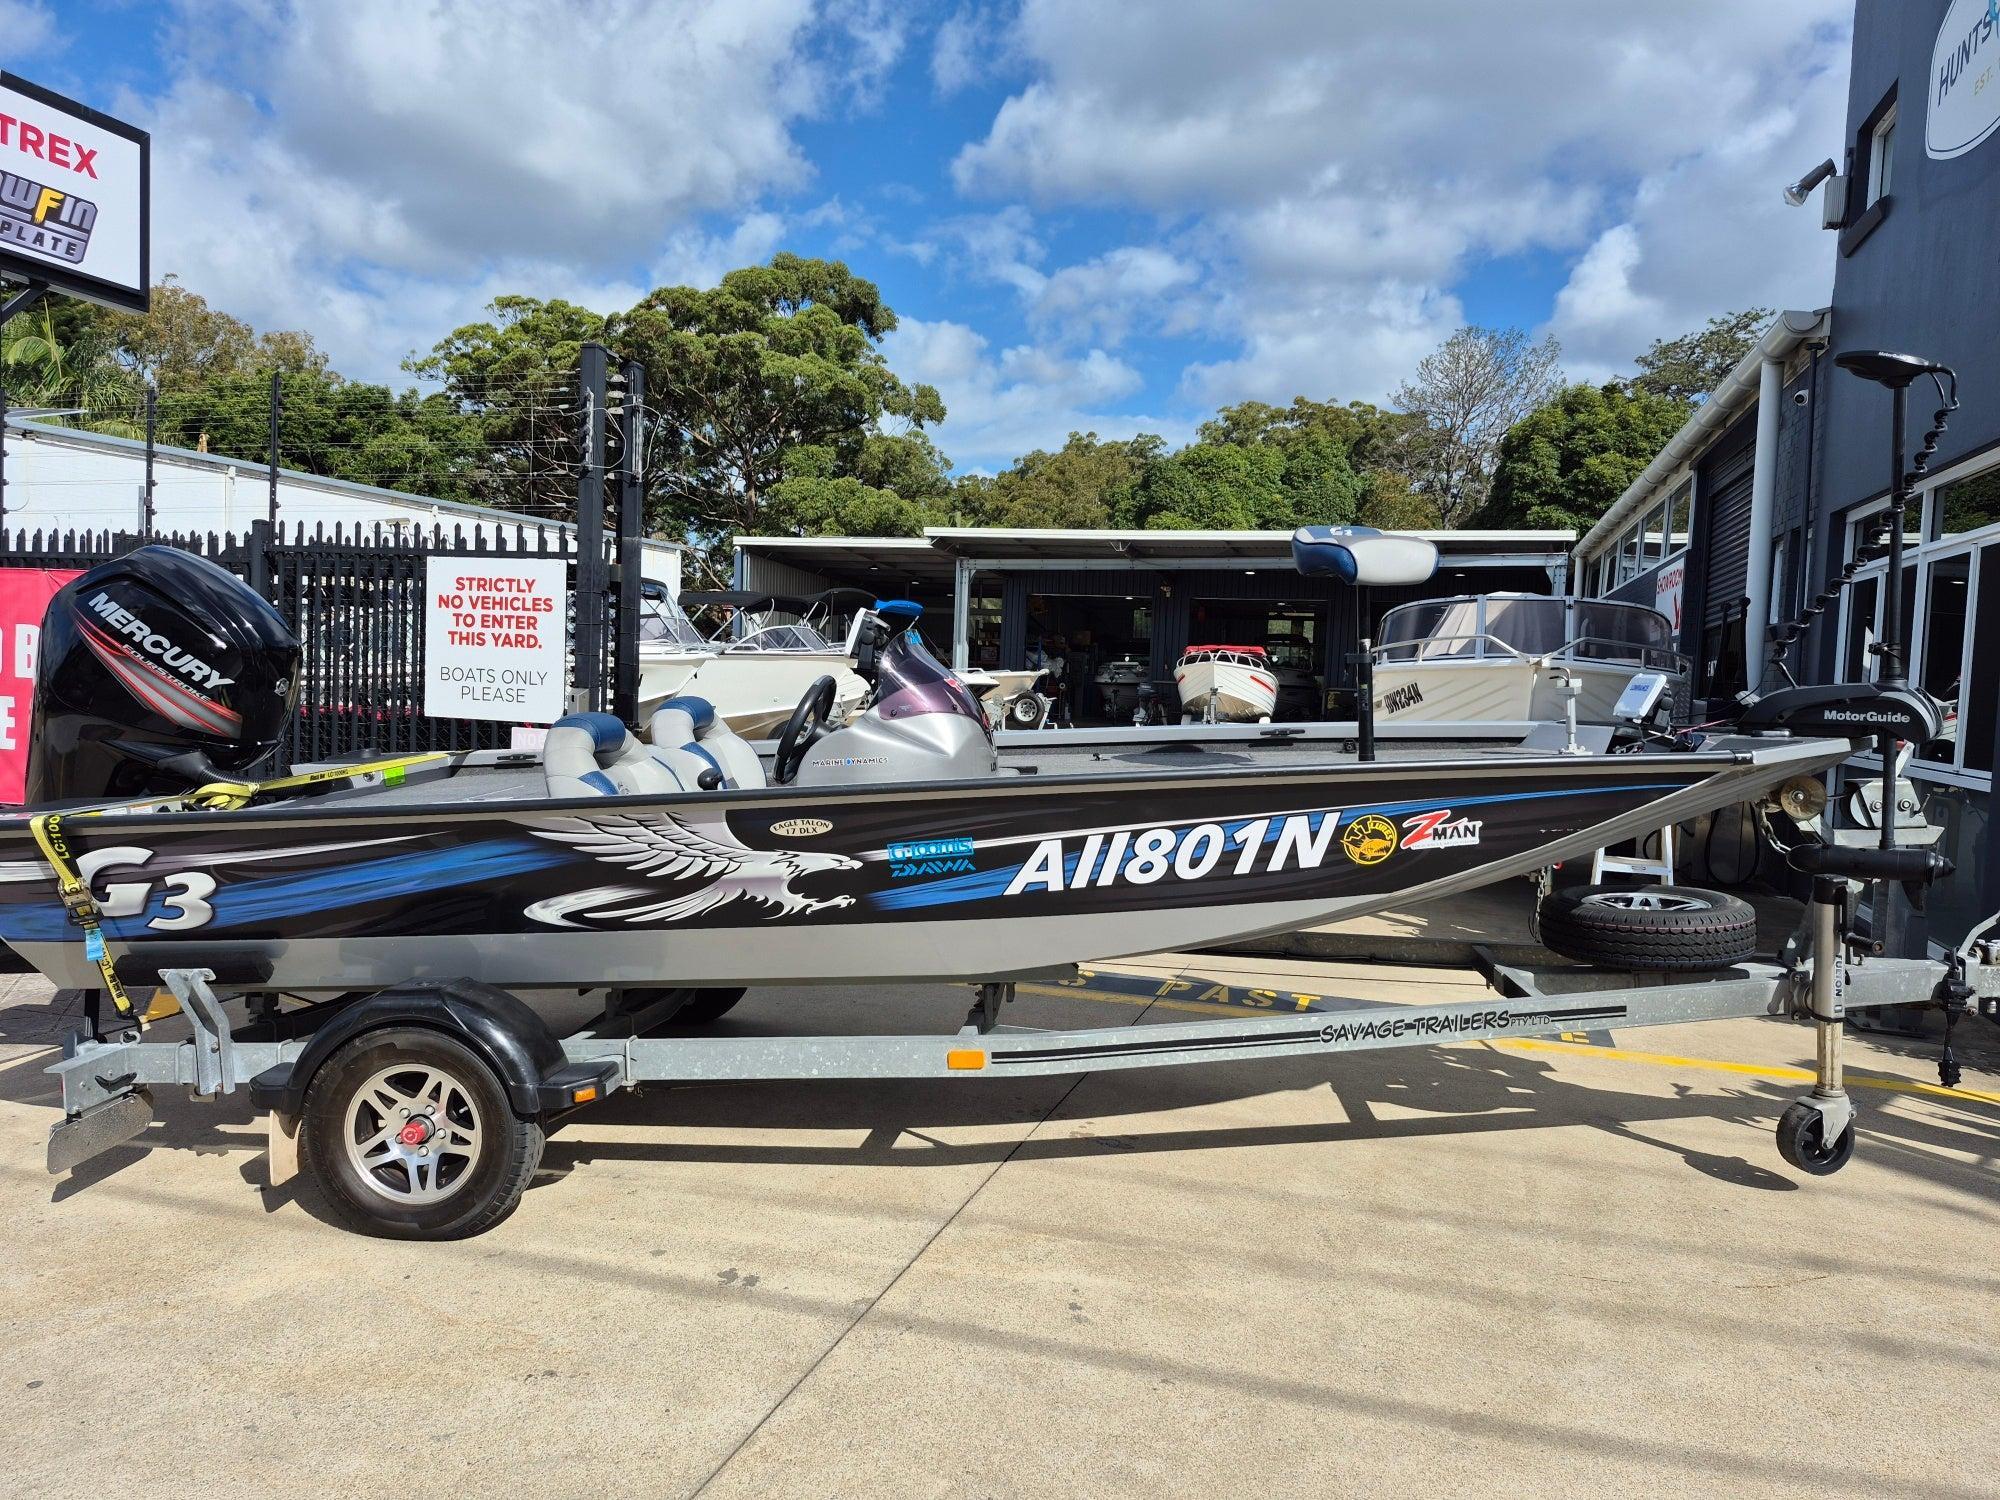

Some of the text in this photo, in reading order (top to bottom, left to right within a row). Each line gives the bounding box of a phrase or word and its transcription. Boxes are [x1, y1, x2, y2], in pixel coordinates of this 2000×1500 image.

[455, 577, 536, 593] STRICTLY
[438, 594, 553, 612] NO VEHICLES
[453, 613, 538, 630] TO ENTER
[88, 592, 236, 690] MERCURY
[448, 631, 543, 649] THIS YARD.
[122, 644, 211, 703] FOURSTROKE
[440, 666, 548, 686] BOATS ONLY
[461, 685, 526, 703] PLEASE
[1823, 709, 1911, 725] MotorGuide
[812, 759, 844, 767] MARINE
[773, 819, 830, 831] EAGLE TALON
[1370, 821, 1393, 841] LURES
[76, 846, 216, 931] G3
[1155, 978, 1321, 1012] PAST
[1319, 1018, 1406, 1043] SAVAGE
[1412, 1009, 1512, 1035] TRAILERS
